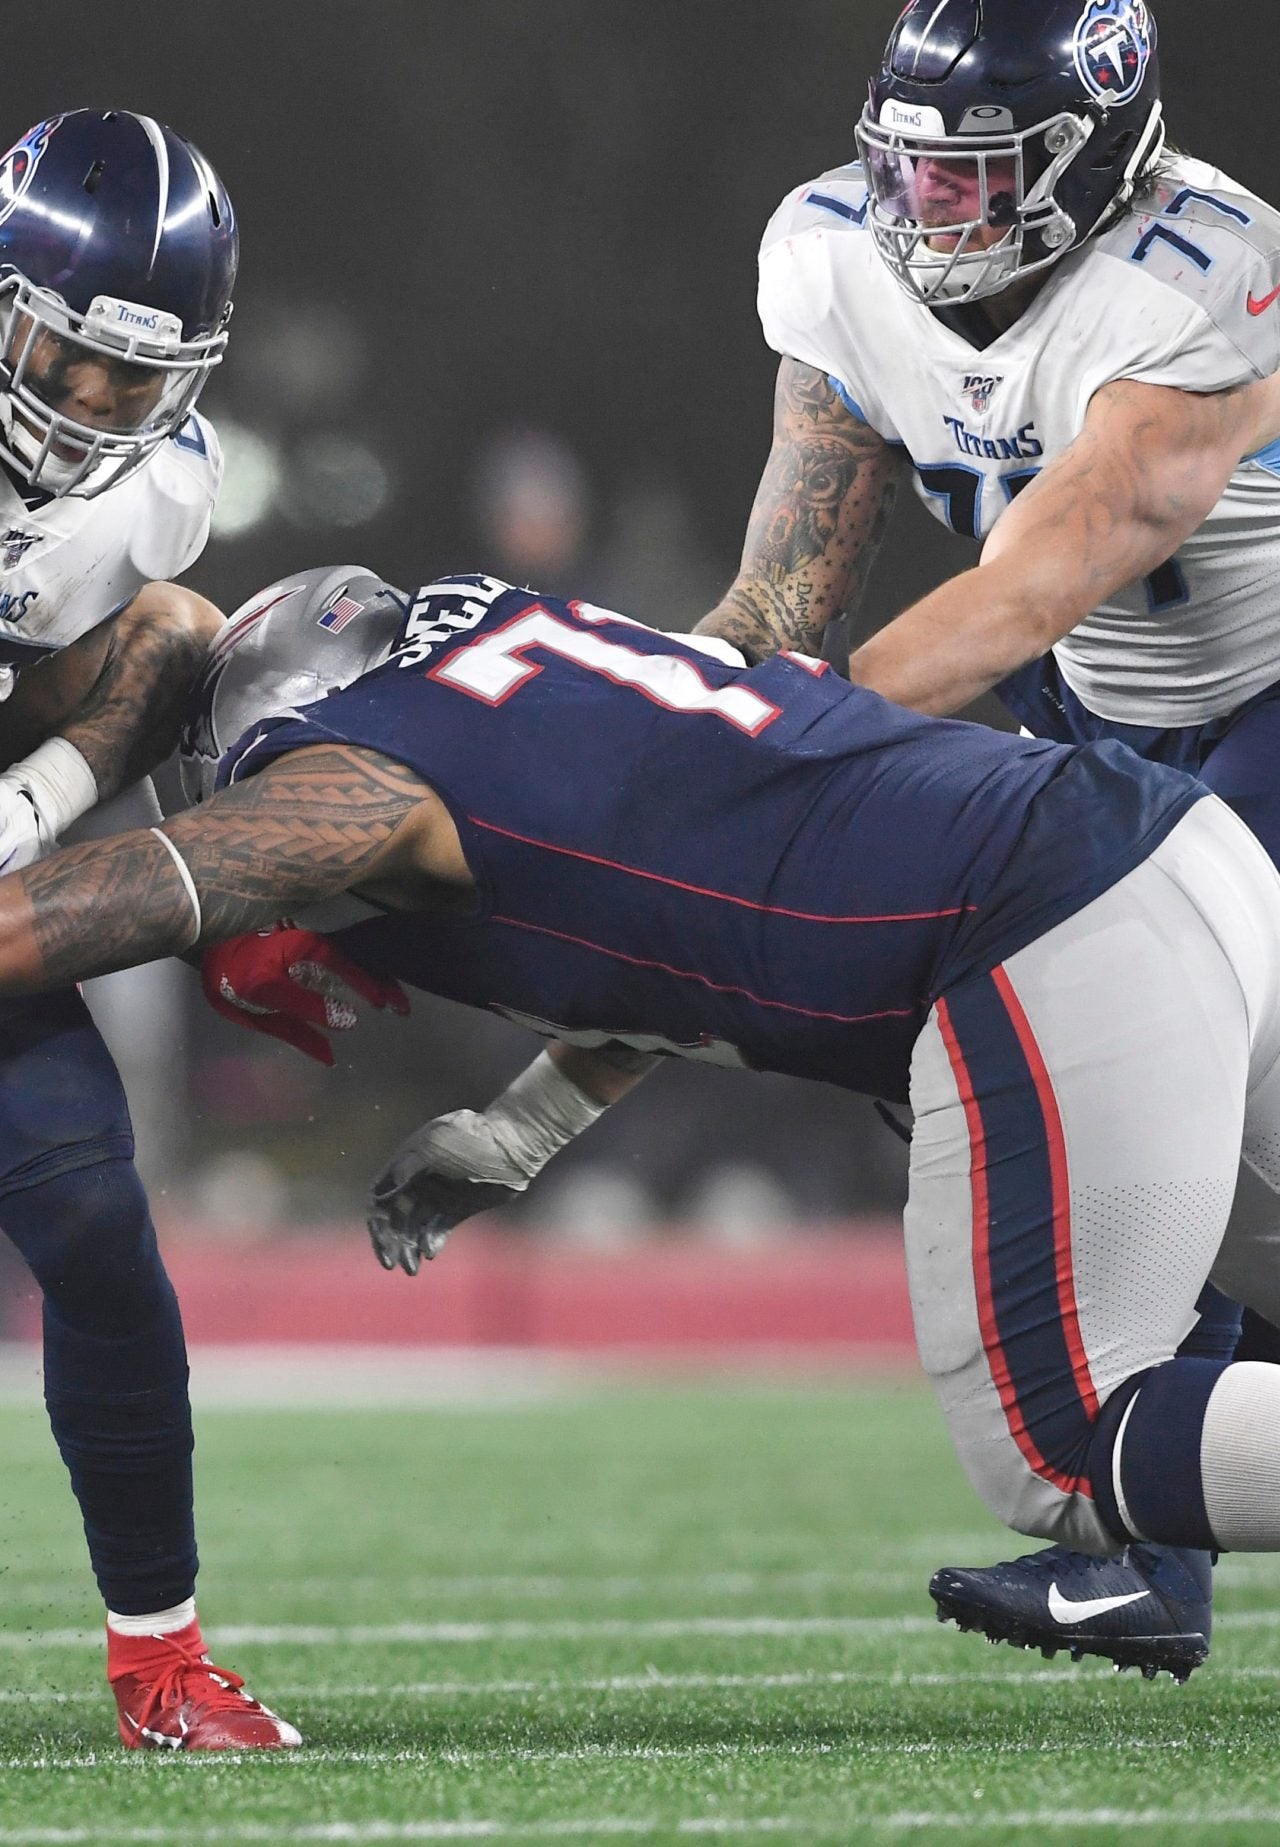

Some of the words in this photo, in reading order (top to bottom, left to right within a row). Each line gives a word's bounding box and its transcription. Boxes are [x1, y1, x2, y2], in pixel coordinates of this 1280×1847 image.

[891, 106, 922, 127] TITANS
[117, 304, 159, 330] TITANS
[942, 415, 1044, 460] TITANS
[794, 582, 813, 631] DAMN
